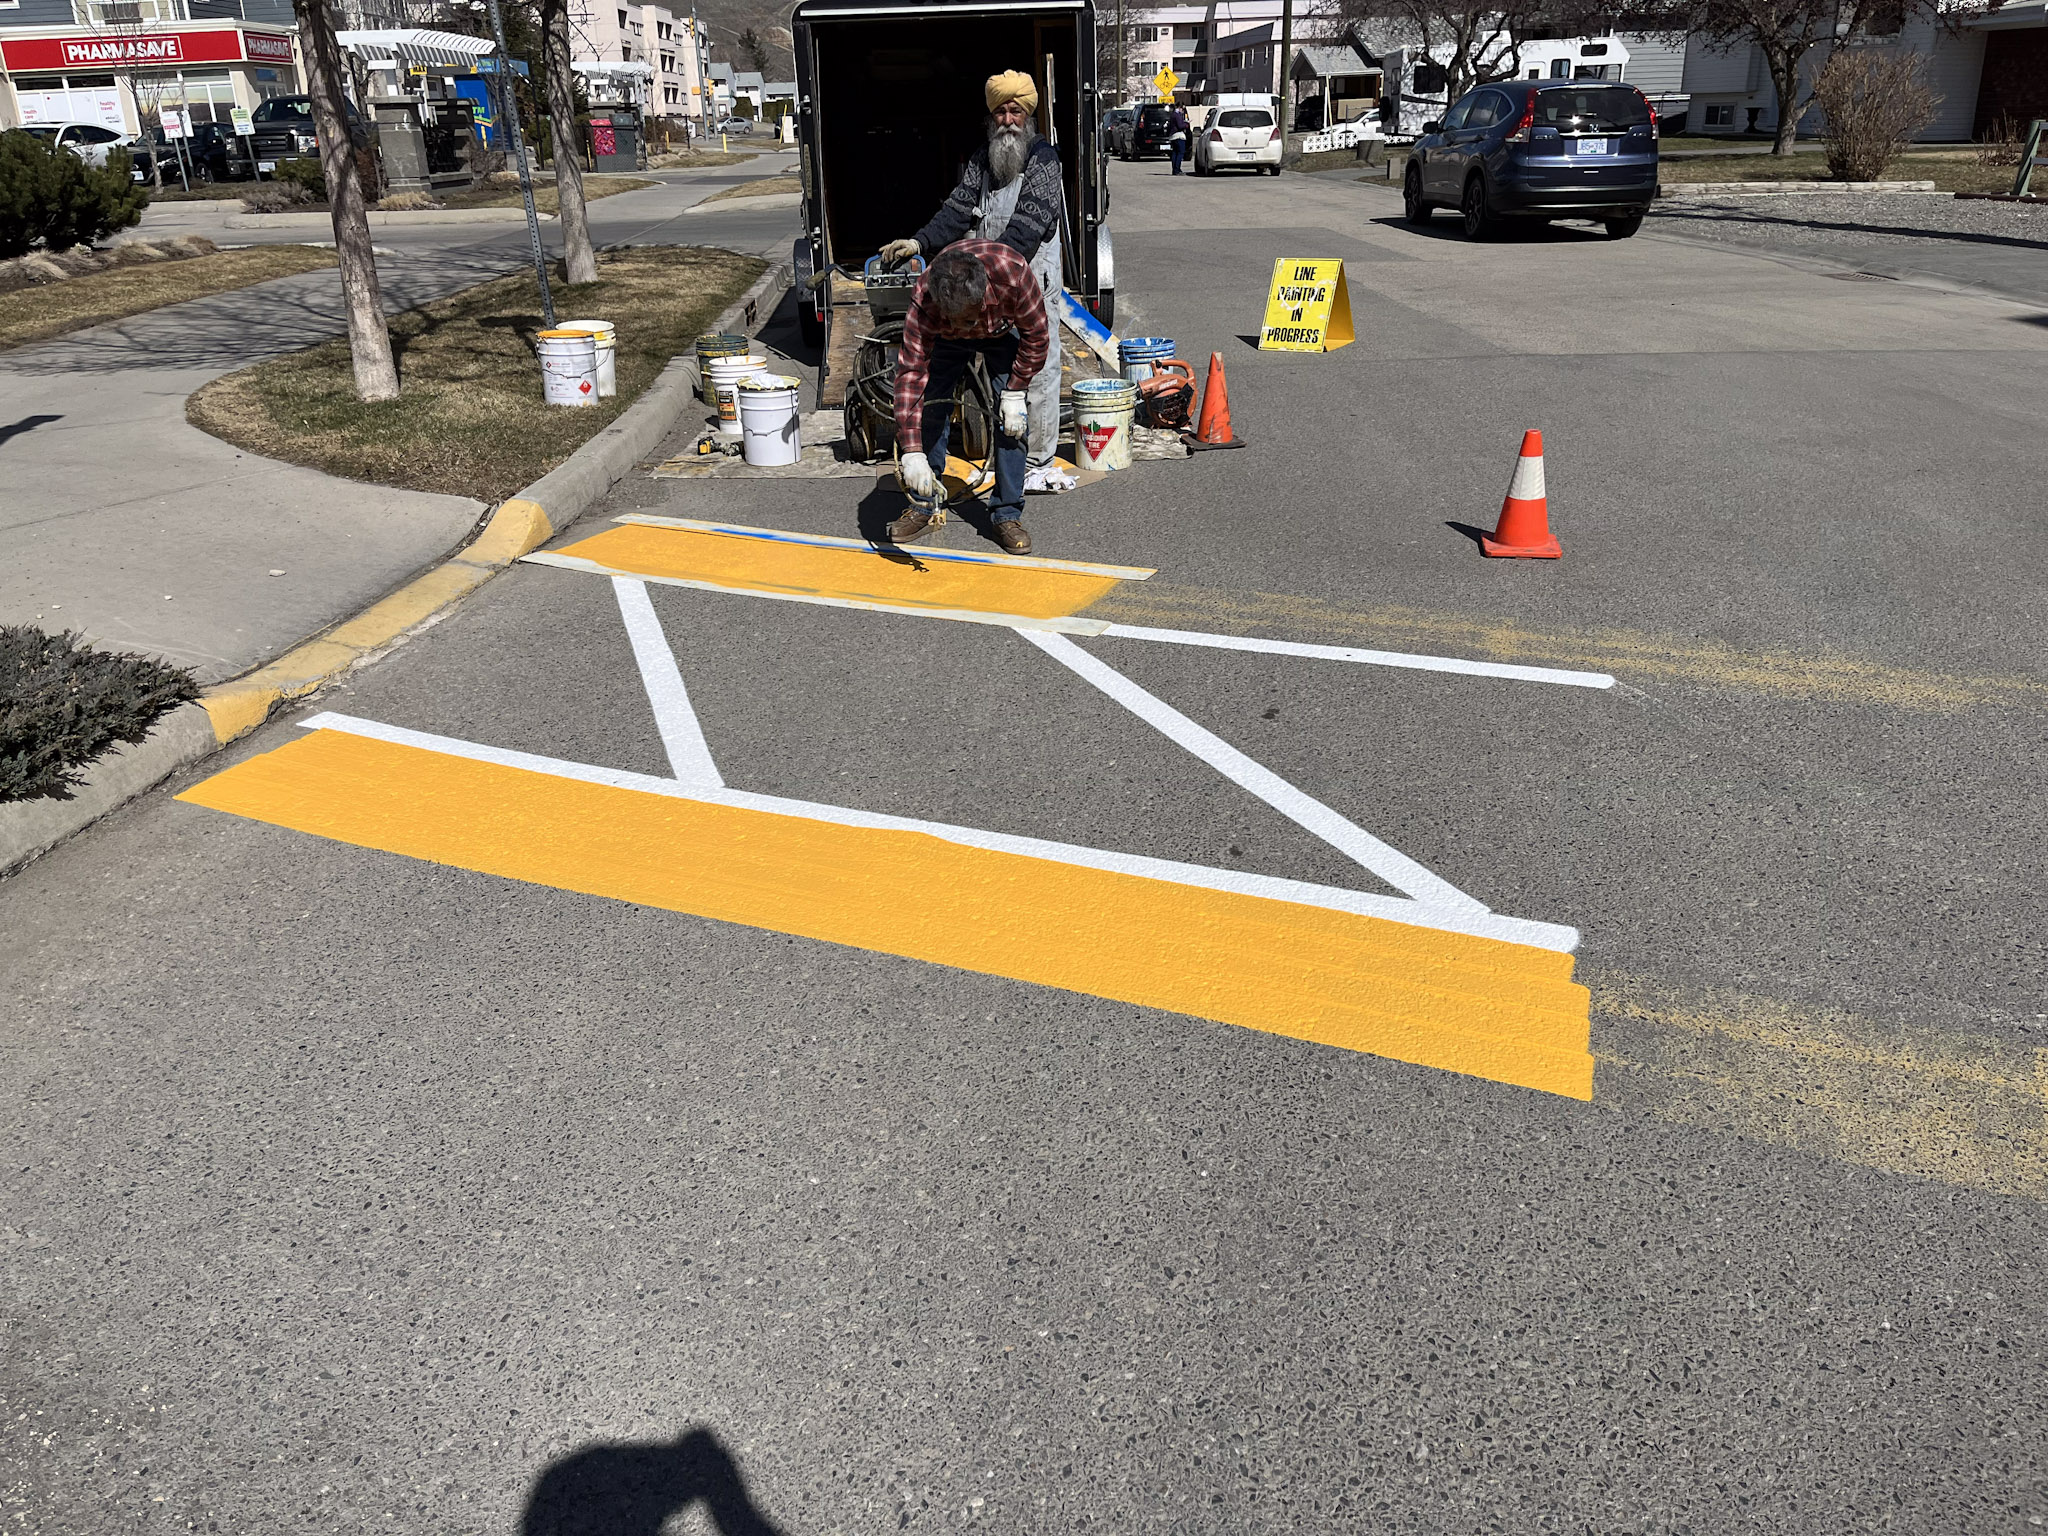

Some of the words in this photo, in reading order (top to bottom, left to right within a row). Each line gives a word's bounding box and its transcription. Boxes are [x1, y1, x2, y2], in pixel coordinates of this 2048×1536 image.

[66, 40, 177, 61] PHARMASAVE
[247, 37, 290, 57] PHARMASAVE
[472, 106, 485, 114] TM
[1294, 266, 1318, 281] LINE
[1277, 286, 1326, 302] PAINTING
[1291, 308, 1304, 322] IN
[1266, 327, 1320, 344] PROGRESS
